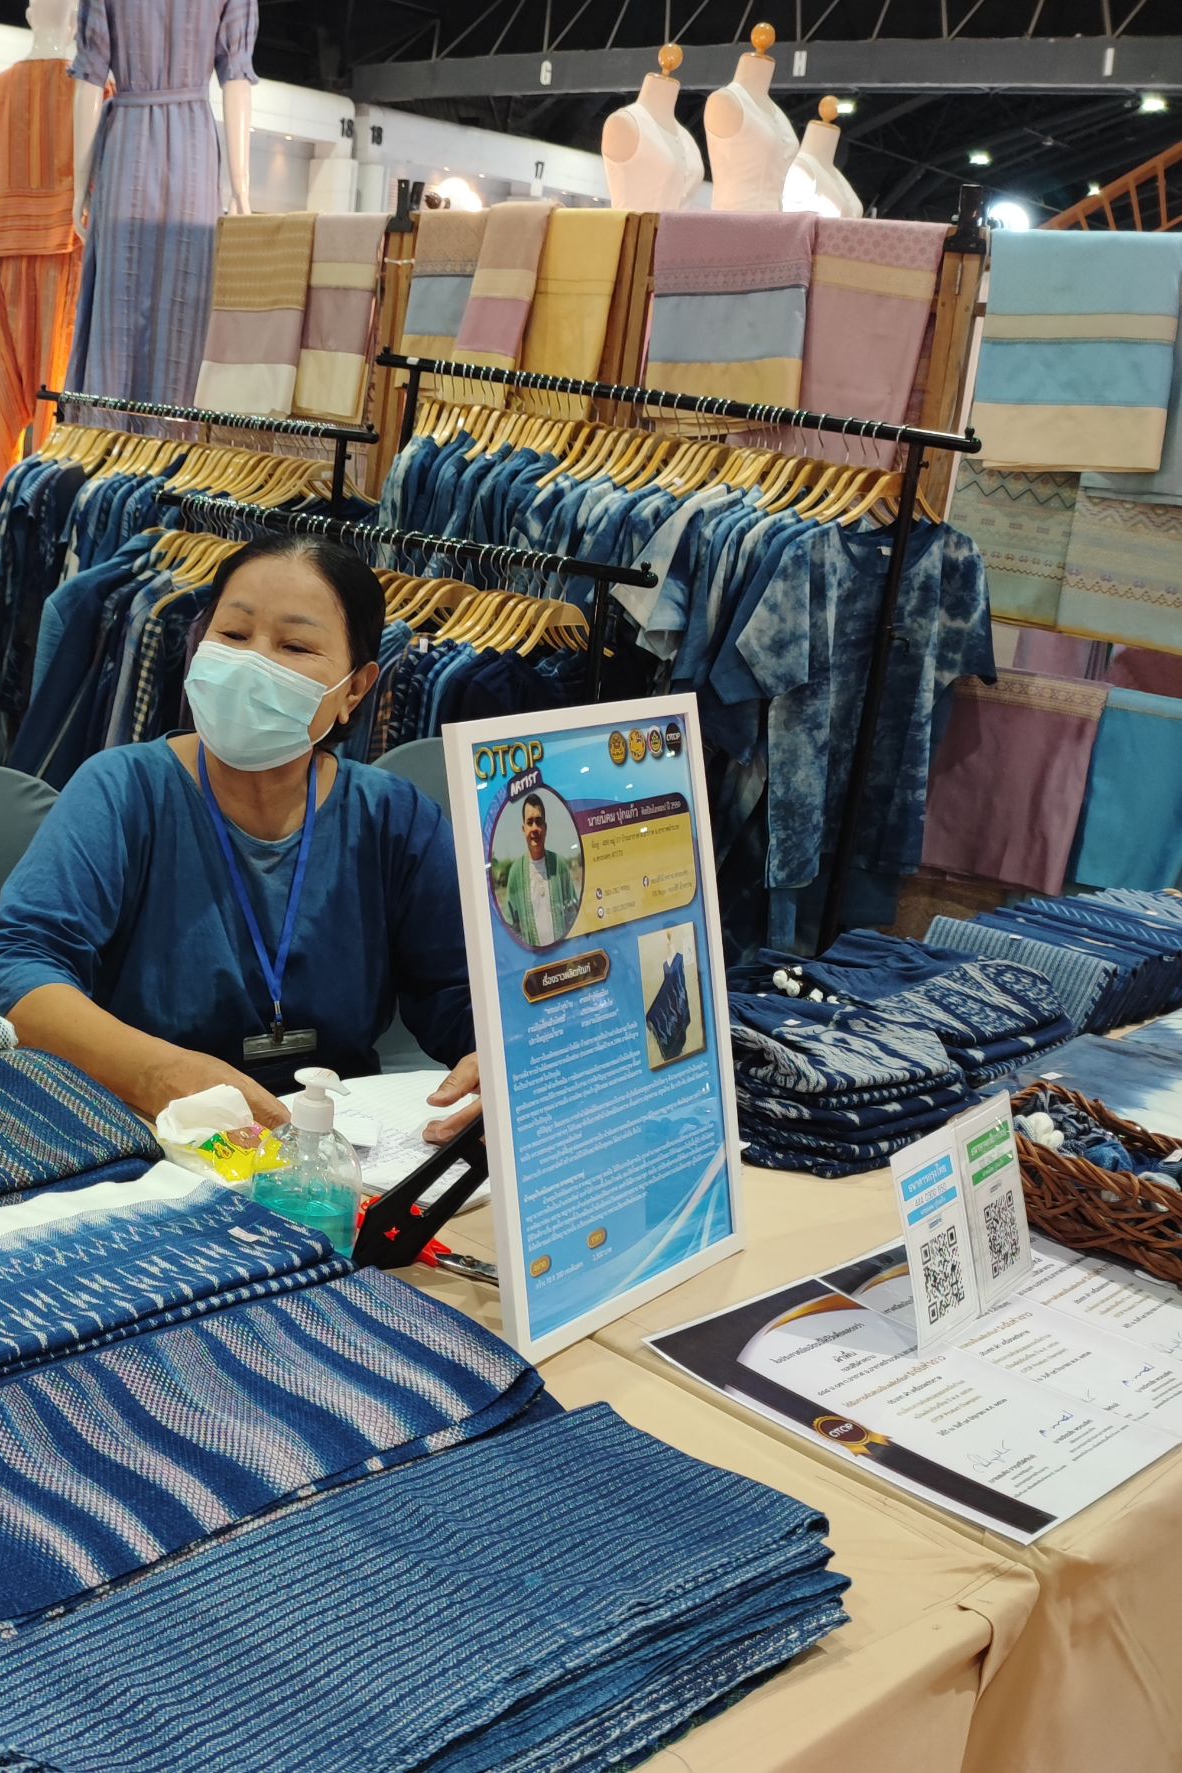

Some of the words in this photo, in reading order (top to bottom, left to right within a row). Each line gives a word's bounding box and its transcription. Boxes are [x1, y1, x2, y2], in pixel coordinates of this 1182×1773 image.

[539, 60, 553, 86] G
[792, 50, 807, 76] H
[340, 117, 354, 138] 18
[535, 161, 545, 179] 17
[474, 740, 542, 779] OTOP
[510, 771, 539, 797] ARTIST
